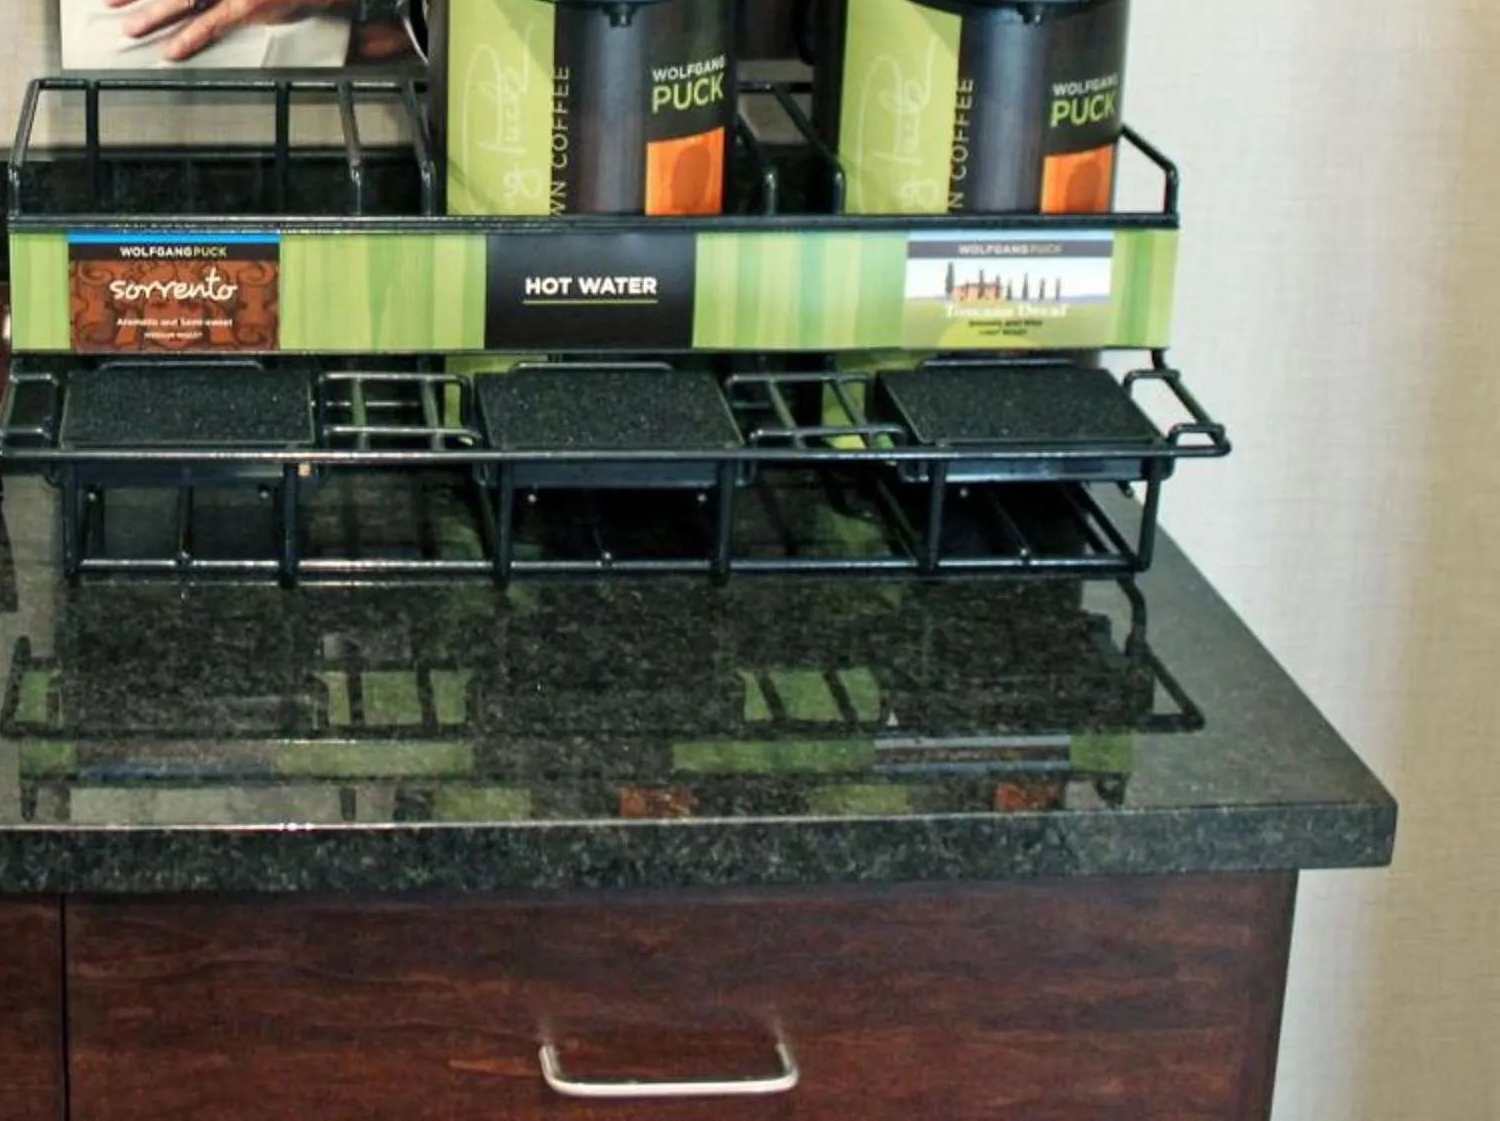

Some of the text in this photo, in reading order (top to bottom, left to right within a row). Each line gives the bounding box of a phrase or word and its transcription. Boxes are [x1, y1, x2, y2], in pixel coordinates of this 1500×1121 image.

[652, 72, 725, 114] PUCK
[1050, 89, 1117, 127] PUCK
[553, 66, 570, 171] COFFEE
[109, 267, 238, 300] sorrento
[525, 277, 658, 295] HOT WATER
